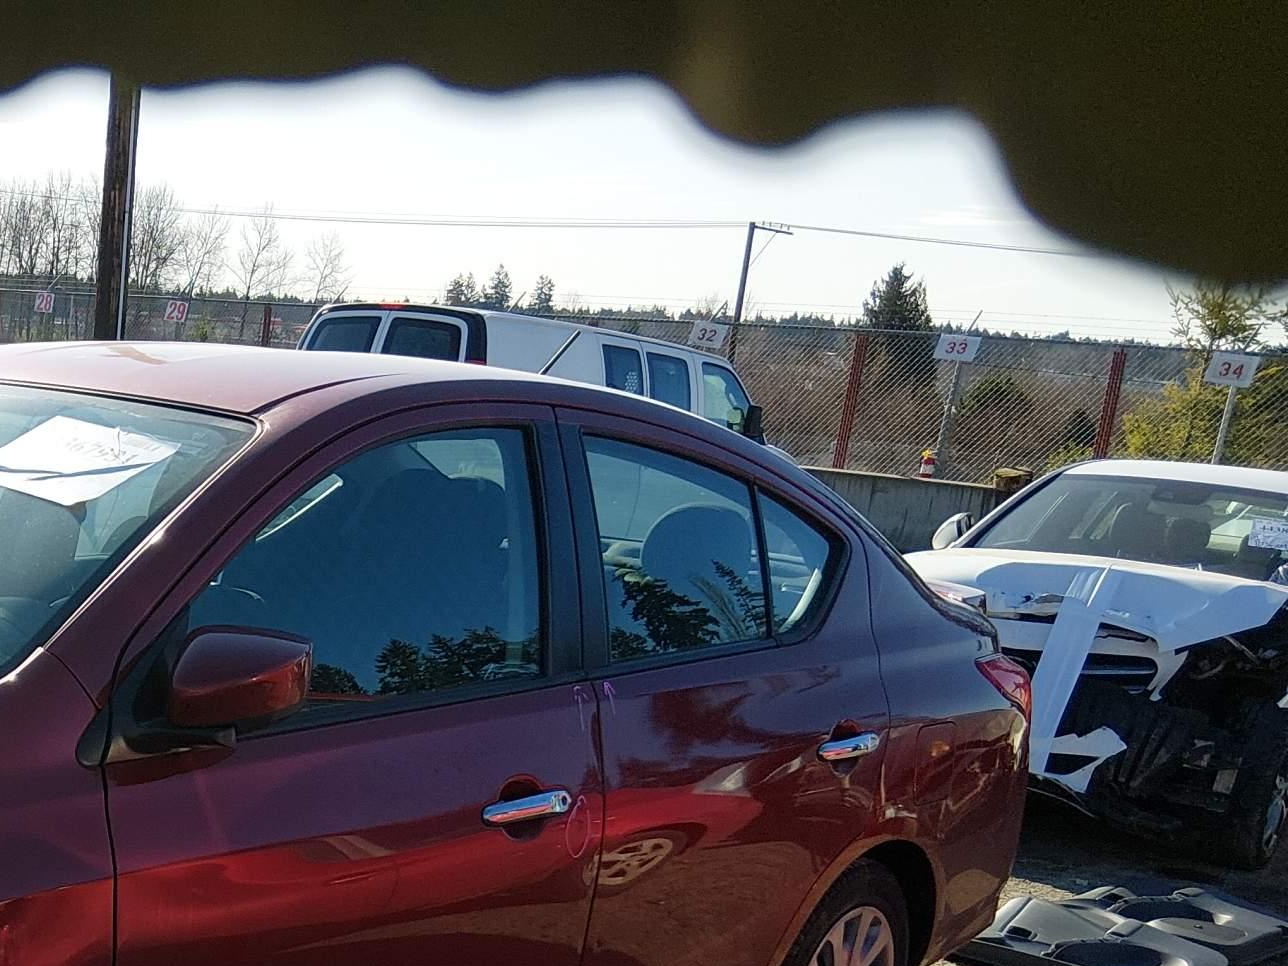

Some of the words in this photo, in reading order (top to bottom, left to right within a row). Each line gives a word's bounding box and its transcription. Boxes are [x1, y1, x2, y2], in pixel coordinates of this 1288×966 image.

[36, 294, 53, 312] 28
[168, 301, 186, 321] 29
[697, 328, 718, 342] 32
[945, 341, 968, 355] 33
[1219, 361, 1245, 379] 34
